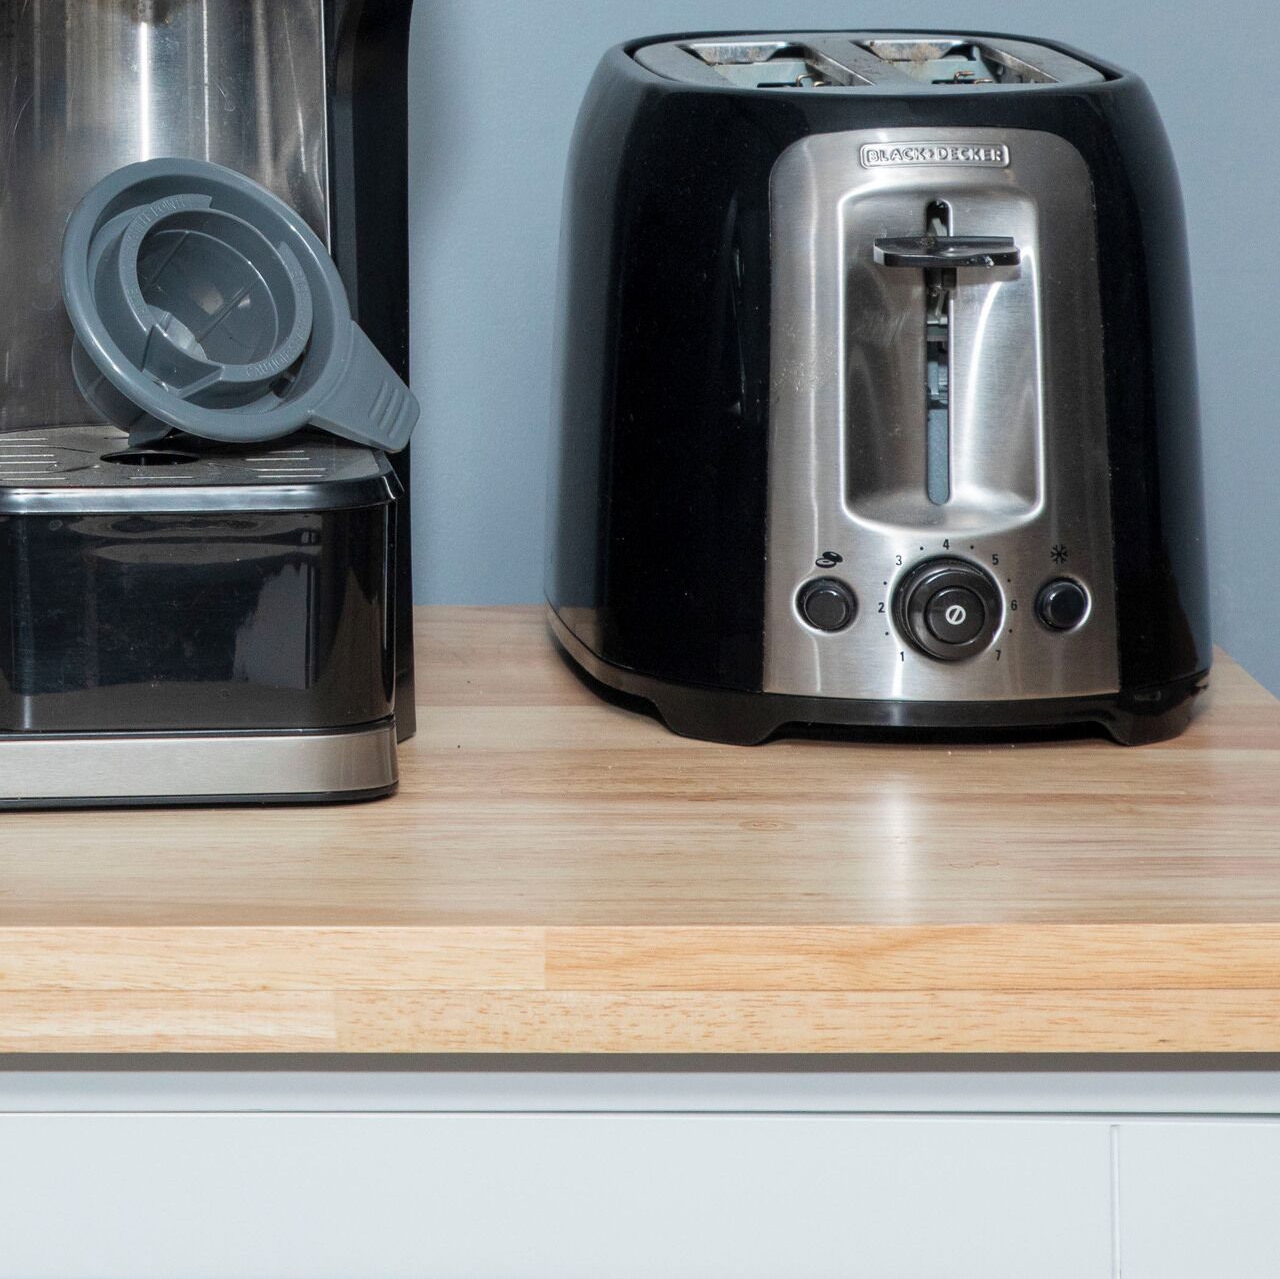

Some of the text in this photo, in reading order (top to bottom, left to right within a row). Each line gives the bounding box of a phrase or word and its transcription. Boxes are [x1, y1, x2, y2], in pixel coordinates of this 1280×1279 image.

[942, 539, 950, 550] 4
[895, 555, 902, 566] 3
[992, 554, 999, 565] 5
[878, 602, 885, 613] 2
[1010, 600, 1018, 611] 6
[900, 651, 905, 662] 1
[995, 650, 1002, 661] 7
